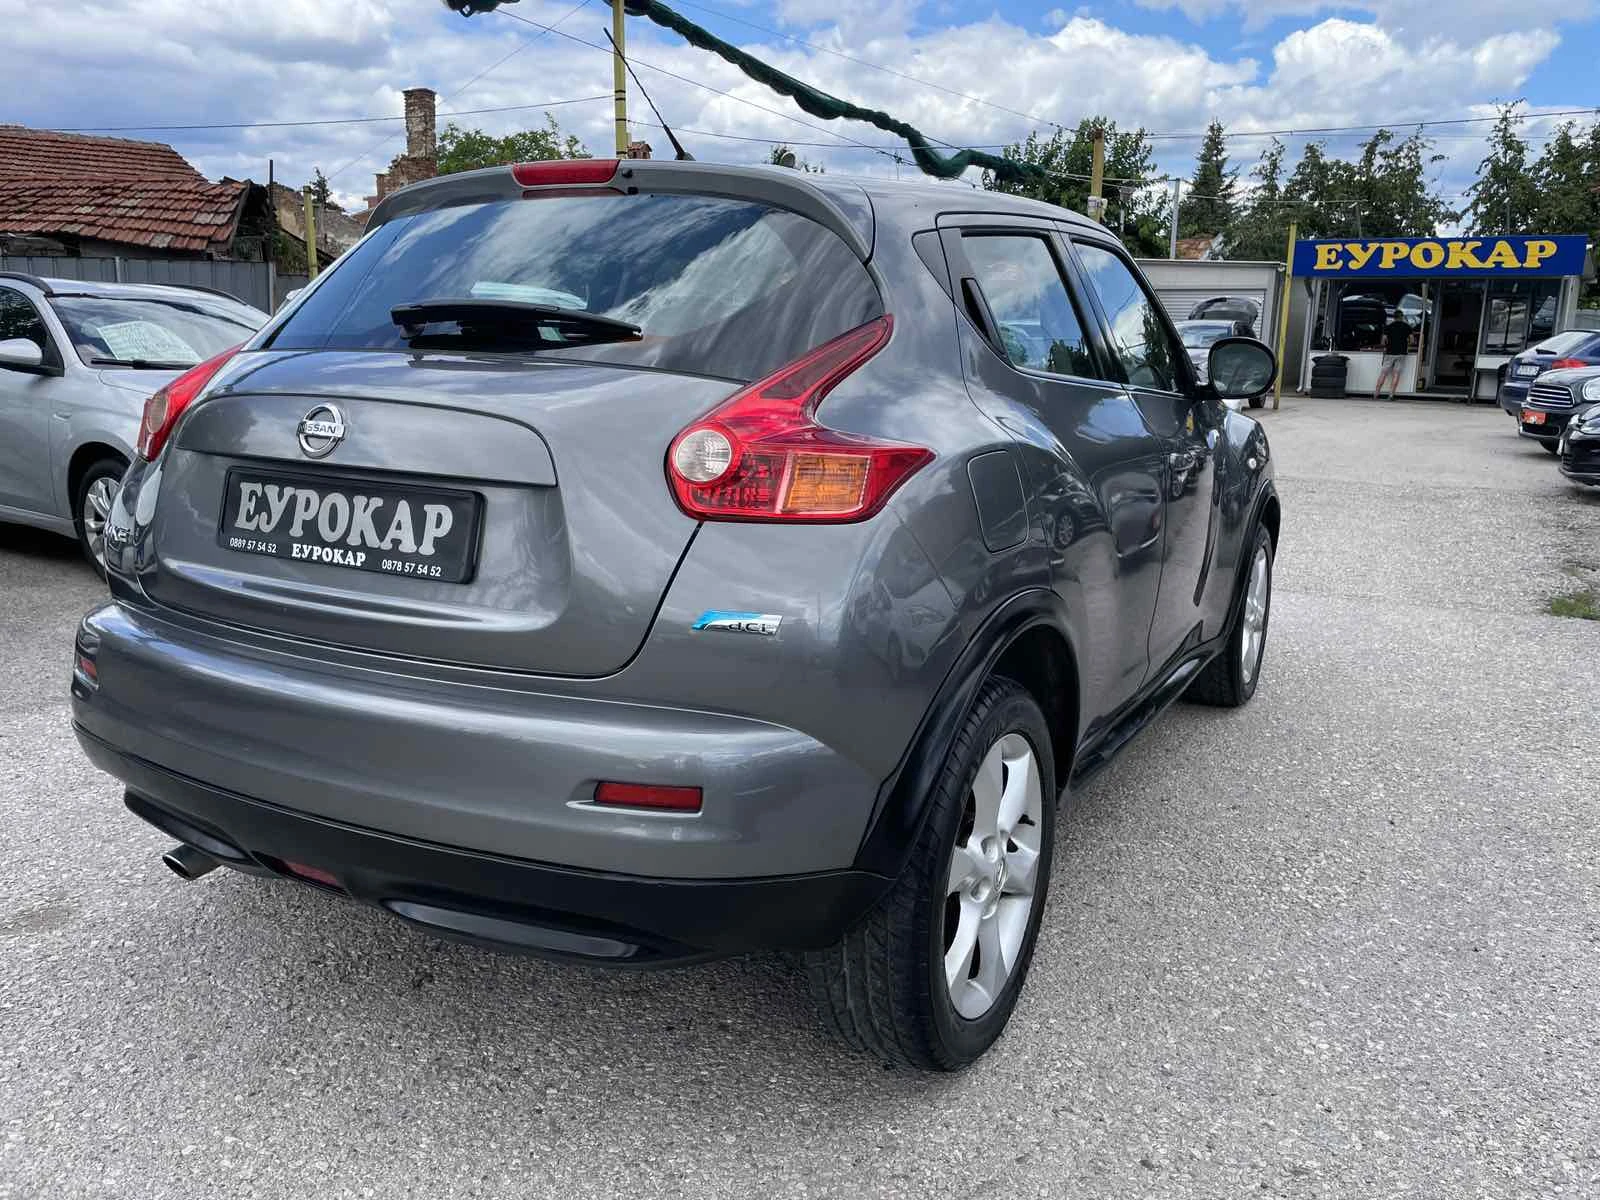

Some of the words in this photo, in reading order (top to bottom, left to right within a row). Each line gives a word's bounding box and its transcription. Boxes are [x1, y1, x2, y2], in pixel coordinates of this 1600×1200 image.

[1313, 240, 1558, 270] ЕУРОКАР
[234, 481, 454, 556] ЕУРОКАР
[247, 539, 256, 551] 57
[257, 541, 266, 552] 54
[267, 543, 277, 553] 52
[291, 543, 366, 567] ЕУРОКАР
[382, 559, 403, 572] 0878
[404, 562, 416, 573] 57
[417, 564, 429, 575] 54
[430, 565, 442, 577] 52
